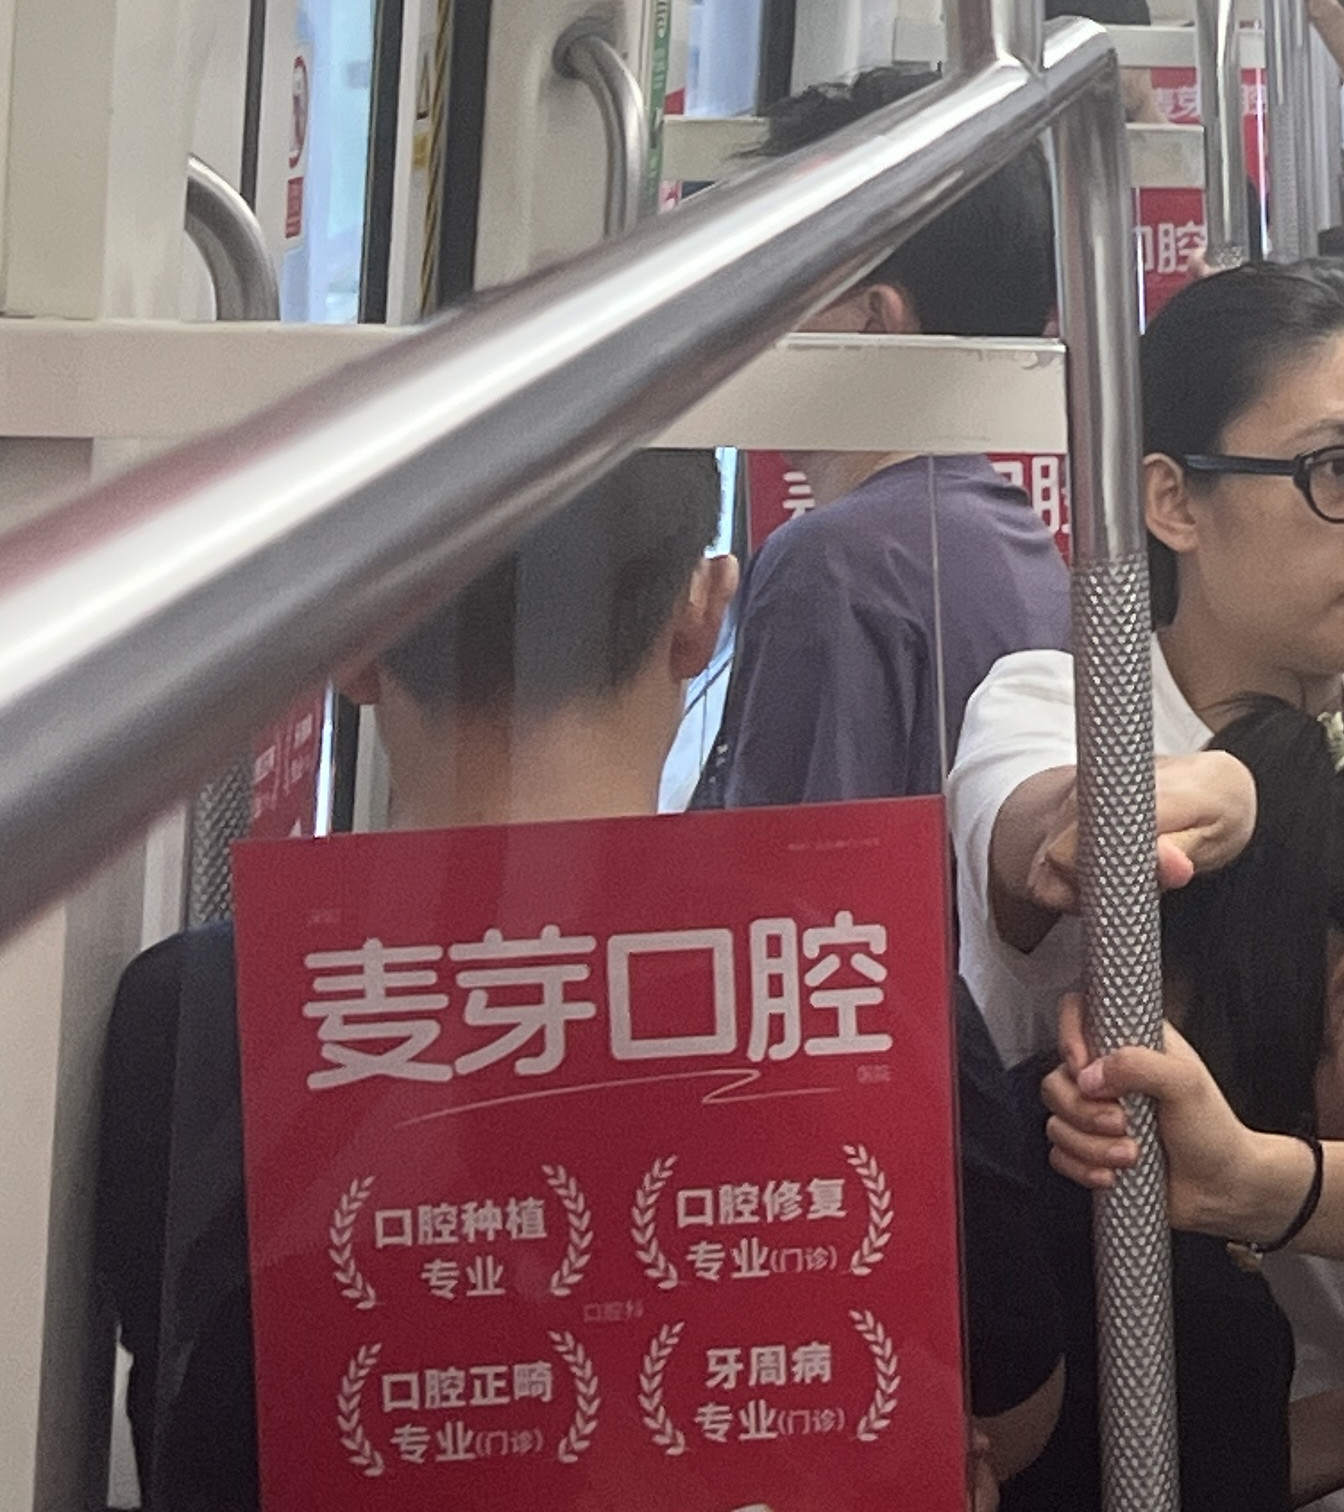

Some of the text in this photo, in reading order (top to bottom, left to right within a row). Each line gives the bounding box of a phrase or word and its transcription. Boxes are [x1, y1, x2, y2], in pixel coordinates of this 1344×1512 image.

[303, 911, 893, 1090] 麦芽口腔
[374, 1197, 548, 1250] 口腔种植
[676, 1177, 847, 1228] 口腔修复
[421, 1257, 505, 1301] 专业
[381, 1360, 555, 1413] 口腔正畸
[705, 1341, 833, 1390] 牙周病
